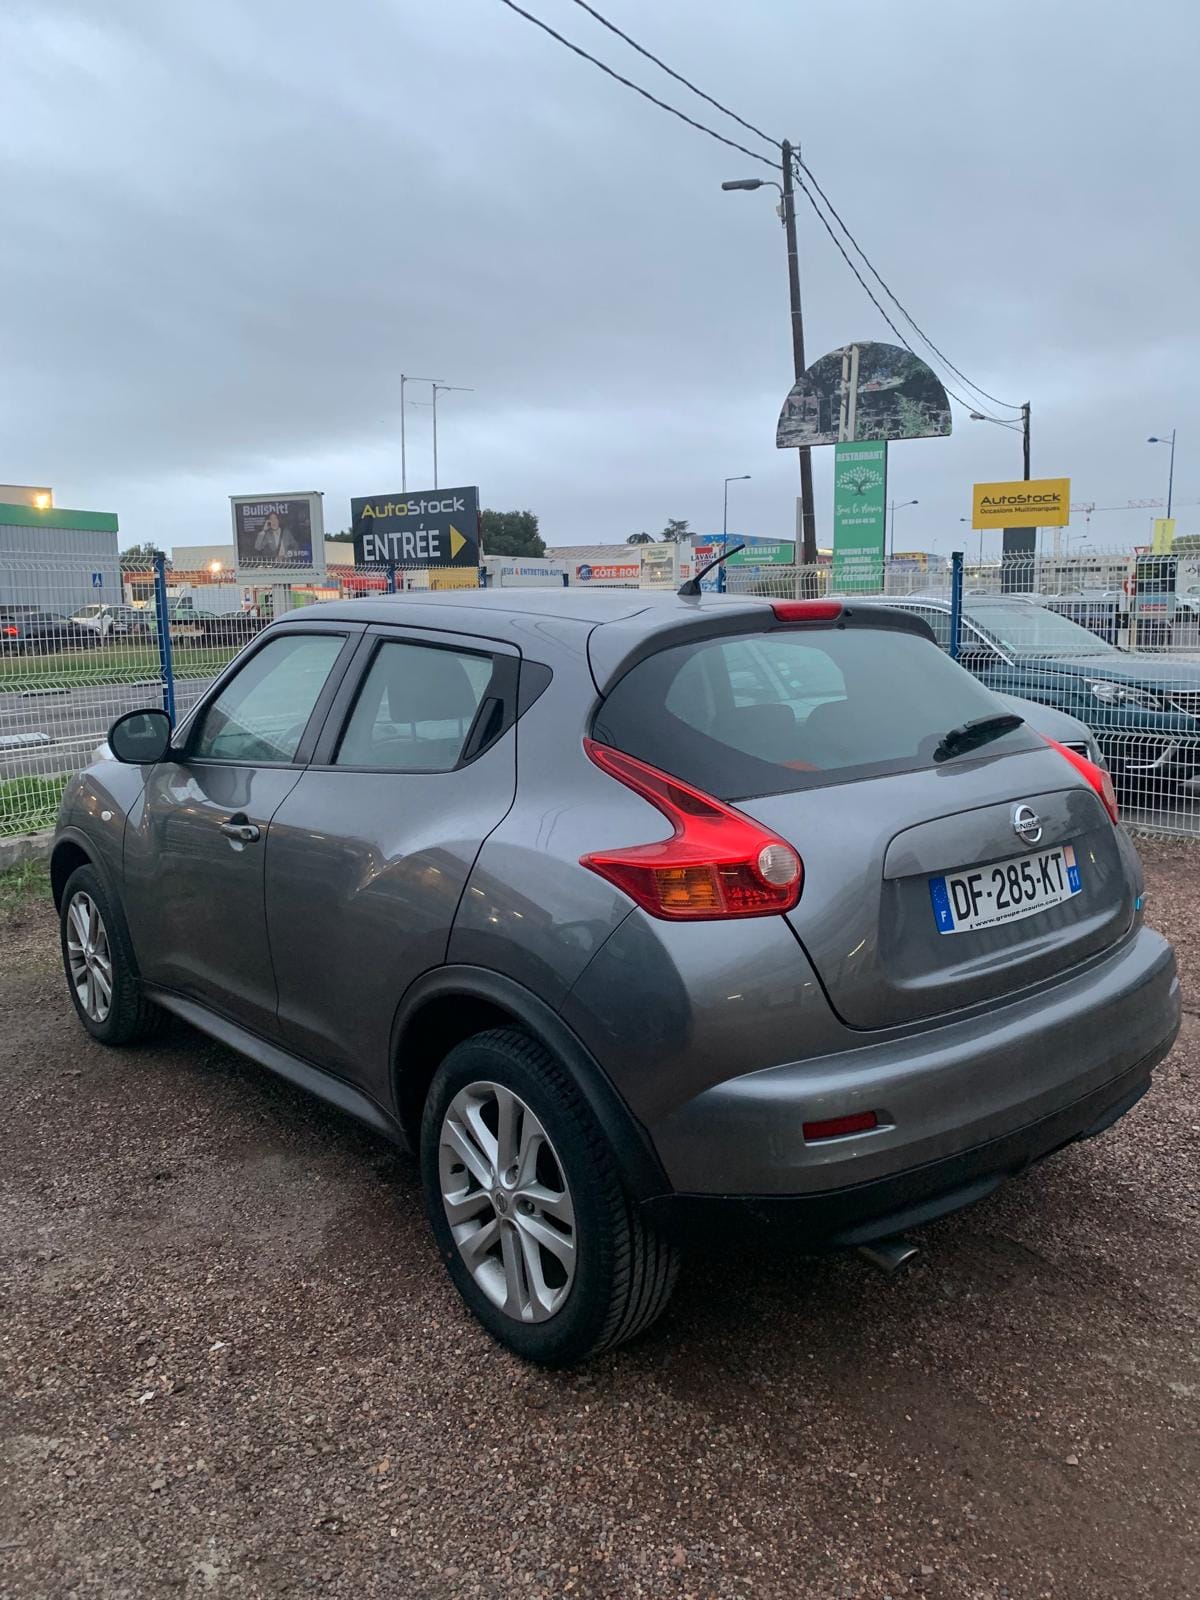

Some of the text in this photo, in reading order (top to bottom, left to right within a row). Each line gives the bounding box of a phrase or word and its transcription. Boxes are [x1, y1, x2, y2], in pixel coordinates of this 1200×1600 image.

[981, 492, 1061, 505] AutoStock
[242, 503, 289, 516] Bullshit!
[361, 496, 465, 519] AutoStock
[362, 523, 441, 561] ENTRÉE
[691, 552, 718, 562] LAVAGE
[520, 568, 549, 576] ENTRETIEN
[1069, 869, 1080, 887] 11
[950, 853, 1064, 921] DF-285-KT
[940, 910, 948, 923] F
